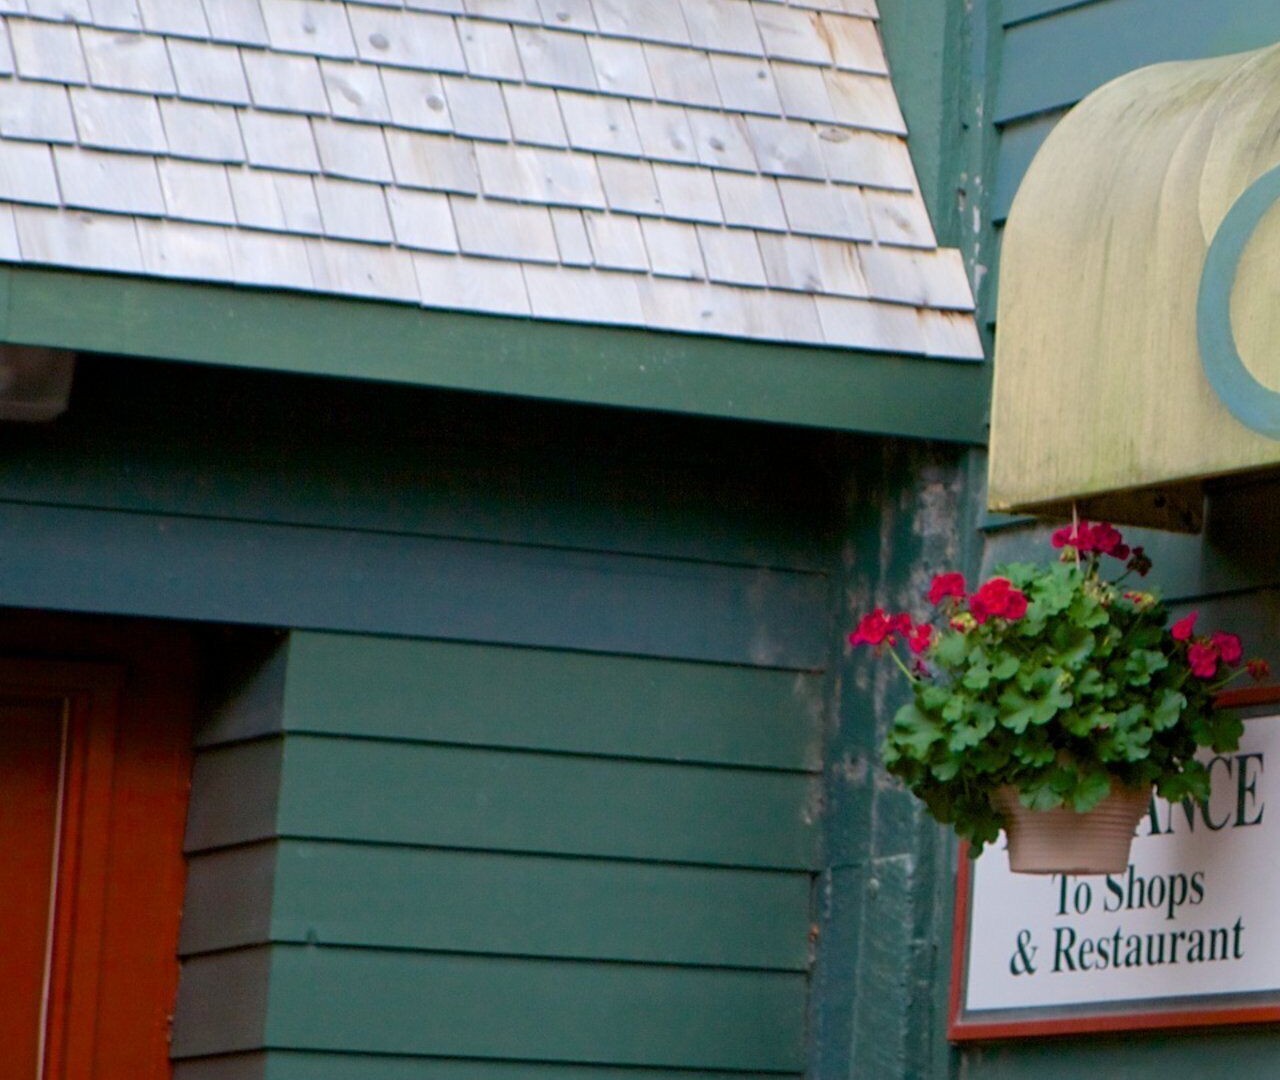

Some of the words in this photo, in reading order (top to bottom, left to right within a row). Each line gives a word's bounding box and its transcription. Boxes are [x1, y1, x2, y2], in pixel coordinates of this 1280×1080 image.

[1052, 872, 1092, 916] To
[1103, 864, 1204, 920] Shops
[1009, 928, 1039, 977] &
[1050, 915, 1246, 975] Restaurant
